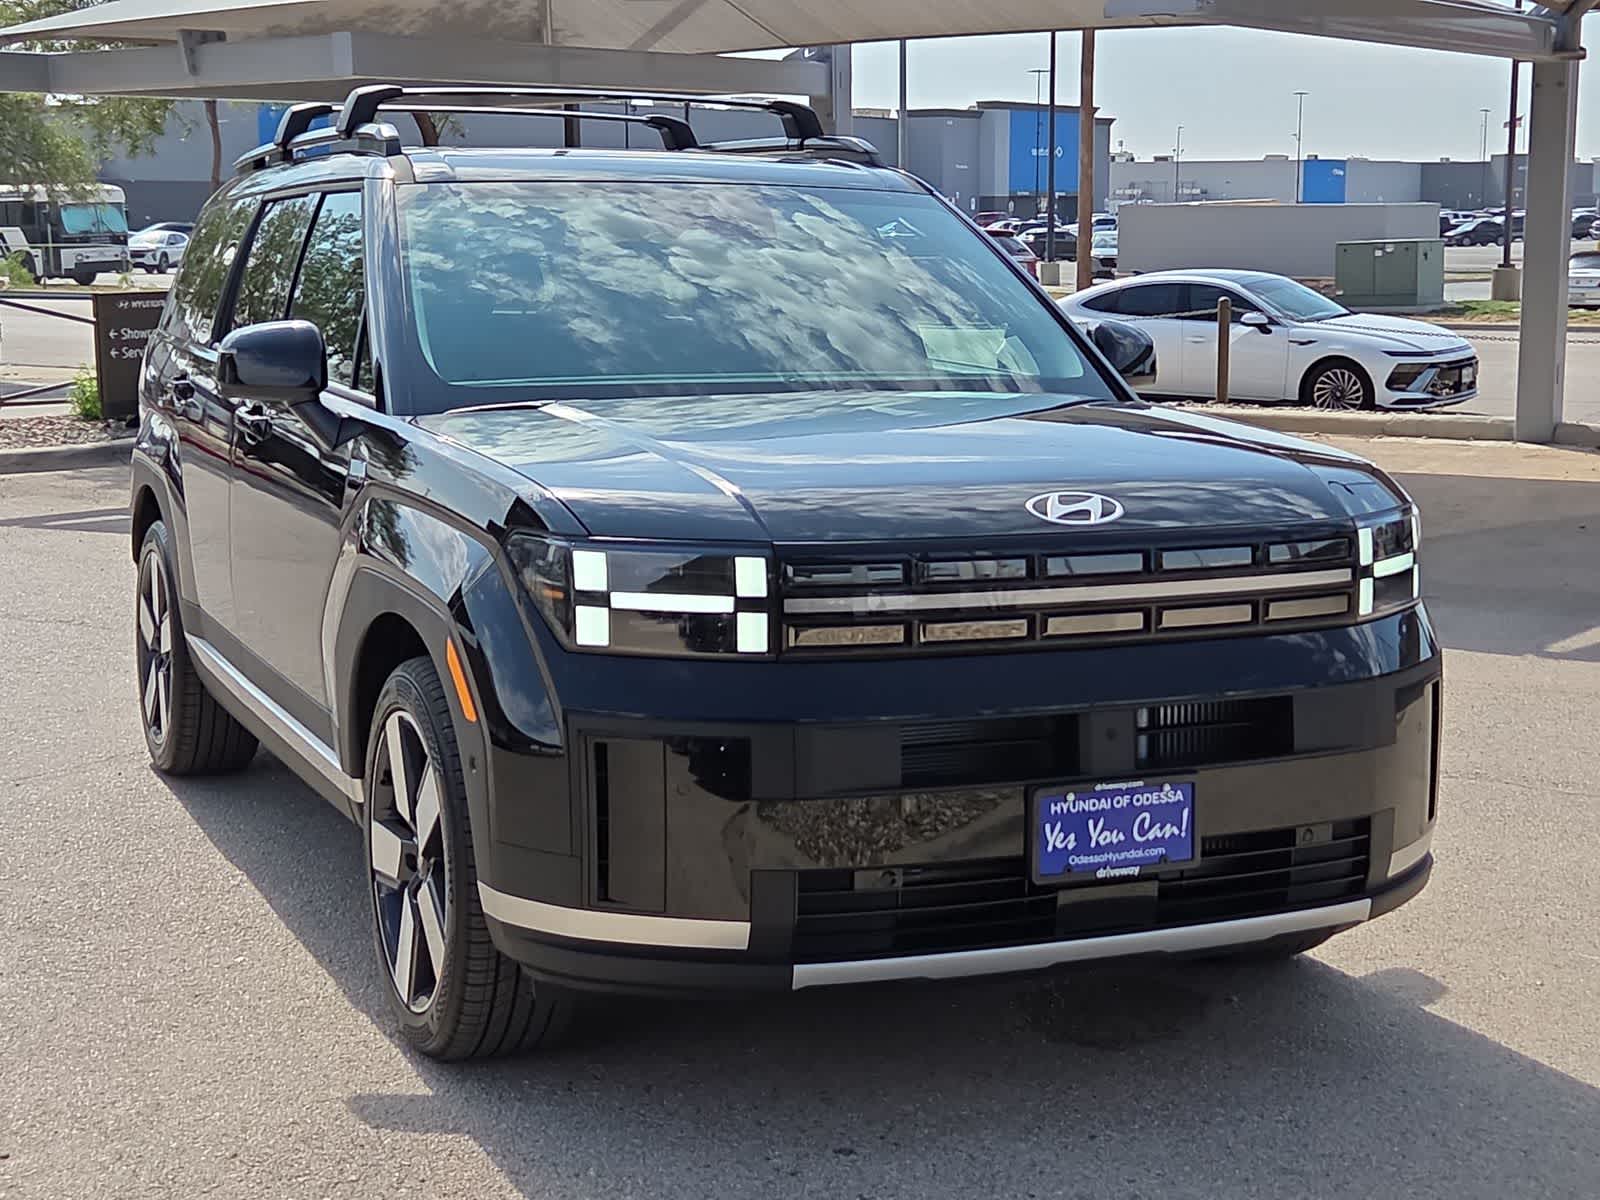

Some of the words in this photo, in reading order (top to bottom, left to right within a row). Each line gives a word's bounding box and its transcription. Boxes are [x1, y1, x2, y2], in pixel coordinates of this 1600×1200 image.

[1050, 797, 1111, 815] HYUNDAI
[1113, 795, 1131, 808] OF
[1133, 790, 1184, 807] ODESSA
[1044, 821, 1077, 852] Yes
[1088, 817, 1125, 848] You
[1132, 807, 1189, 842] Can!
[1068, 847, 1166, 865] OdessaHyundai.com
[1096, 865, 1140, 879] driveway
